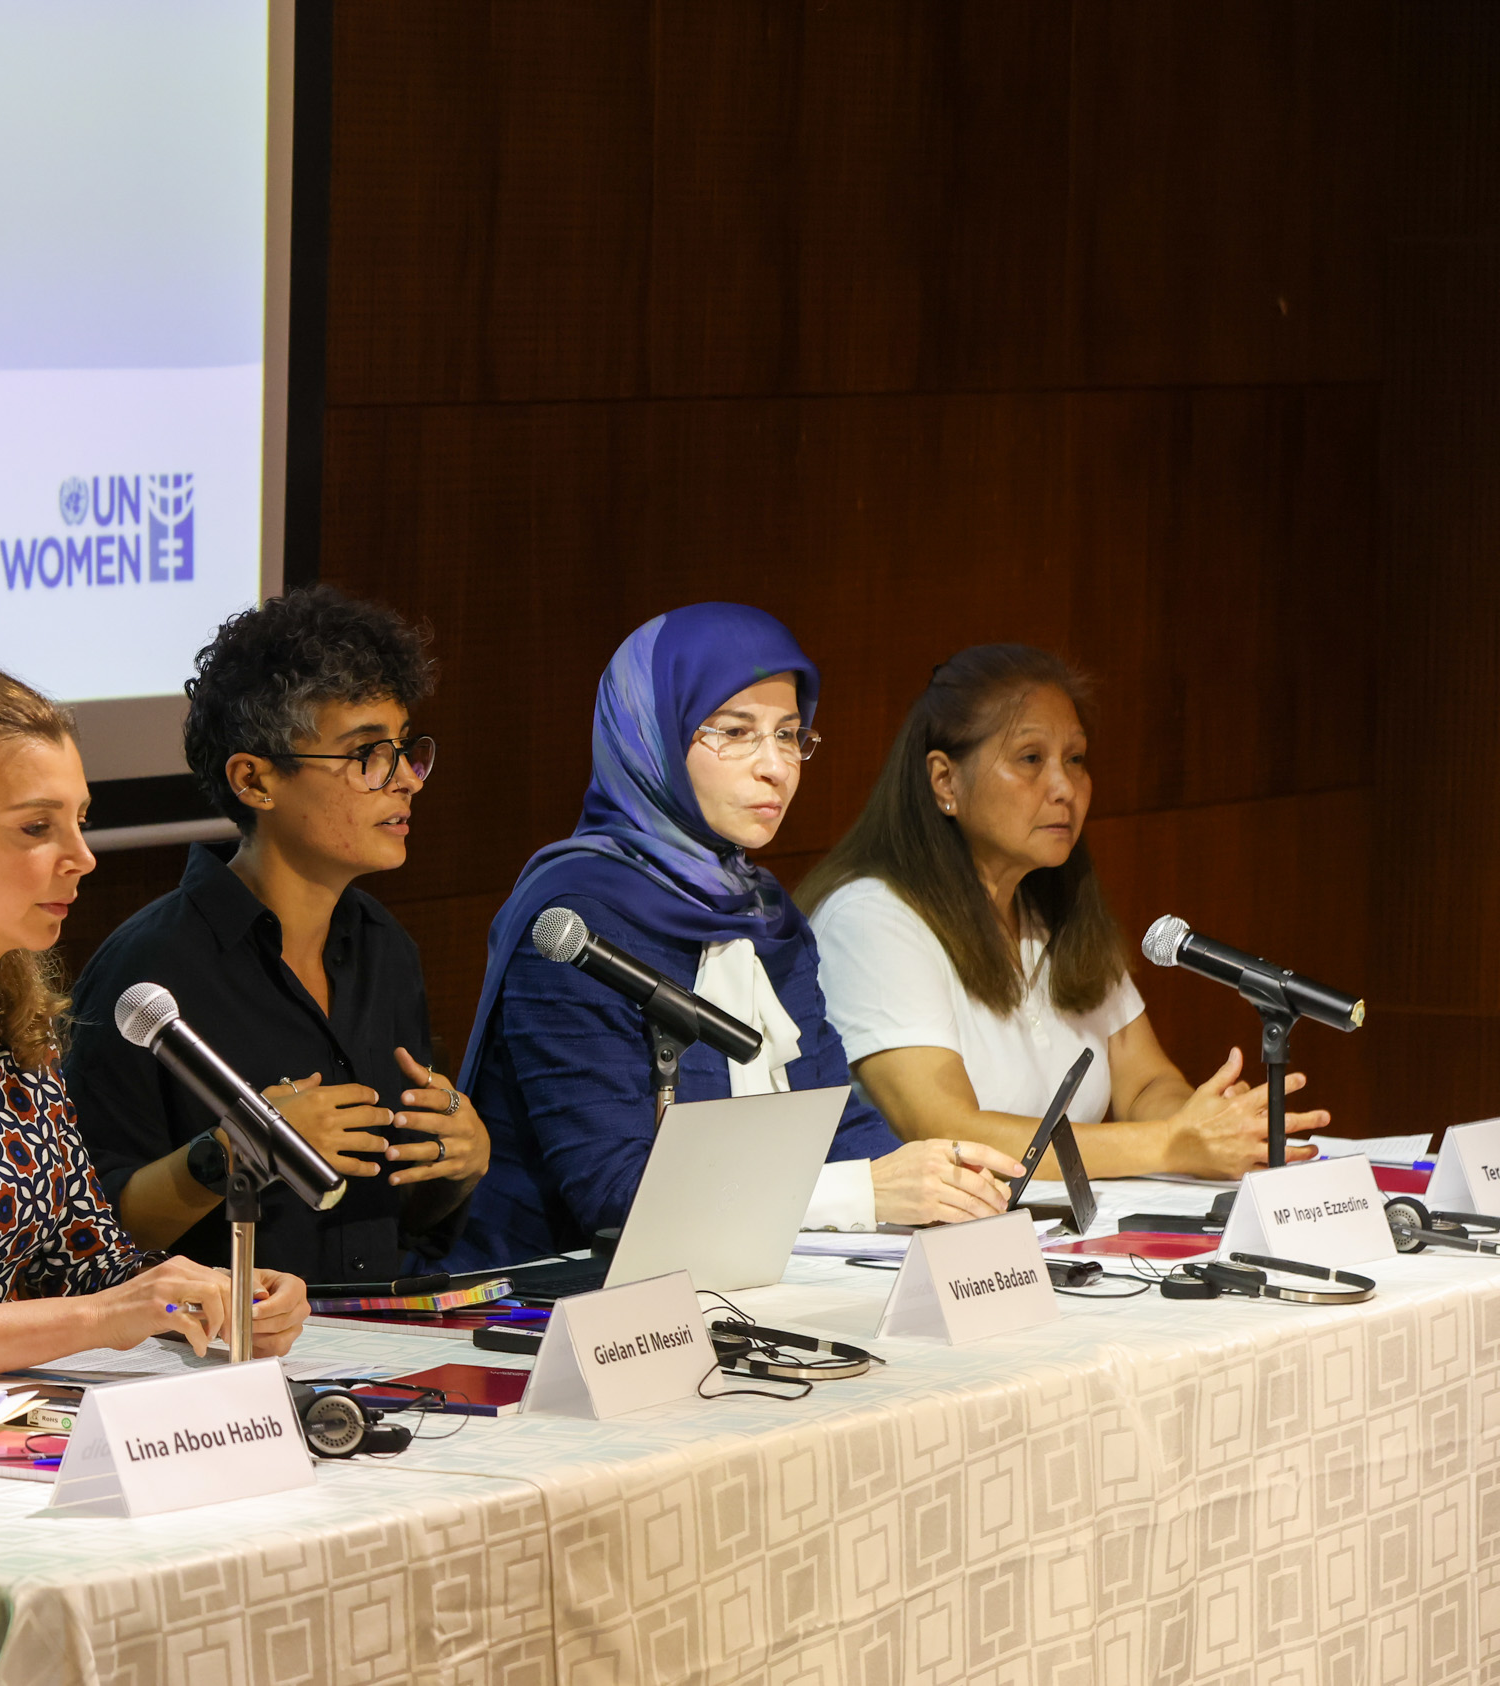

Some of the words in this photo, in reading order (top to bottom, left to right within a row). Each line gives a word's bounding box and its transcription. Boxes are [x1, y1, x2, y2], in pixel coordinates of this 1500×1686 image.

[93, 474, 141, 526] UN
[0, 534, 140, 591] WOMEN
[1273, 1208, 1291, 1226] MP
[1293, 1206, 1323, 1223] Inaya
[1323, 1197, 1369, 1216] Ezzedine
[948, 1277, 996, 1301] Viviane
[994, 1267, 1039, 1291] Badaan
[594, 1341, 636, 1365] Gielan
[635, 1334, 651, 1355] El
[649, 1324, 694, 1352] Messiri
[41, 1415, 59, 1424] RoHS
[125, 1437, 170, 1462] Lina
[173, 1427, 227, 1454] Abou
[226, 1415, 284, 1443] Habib
